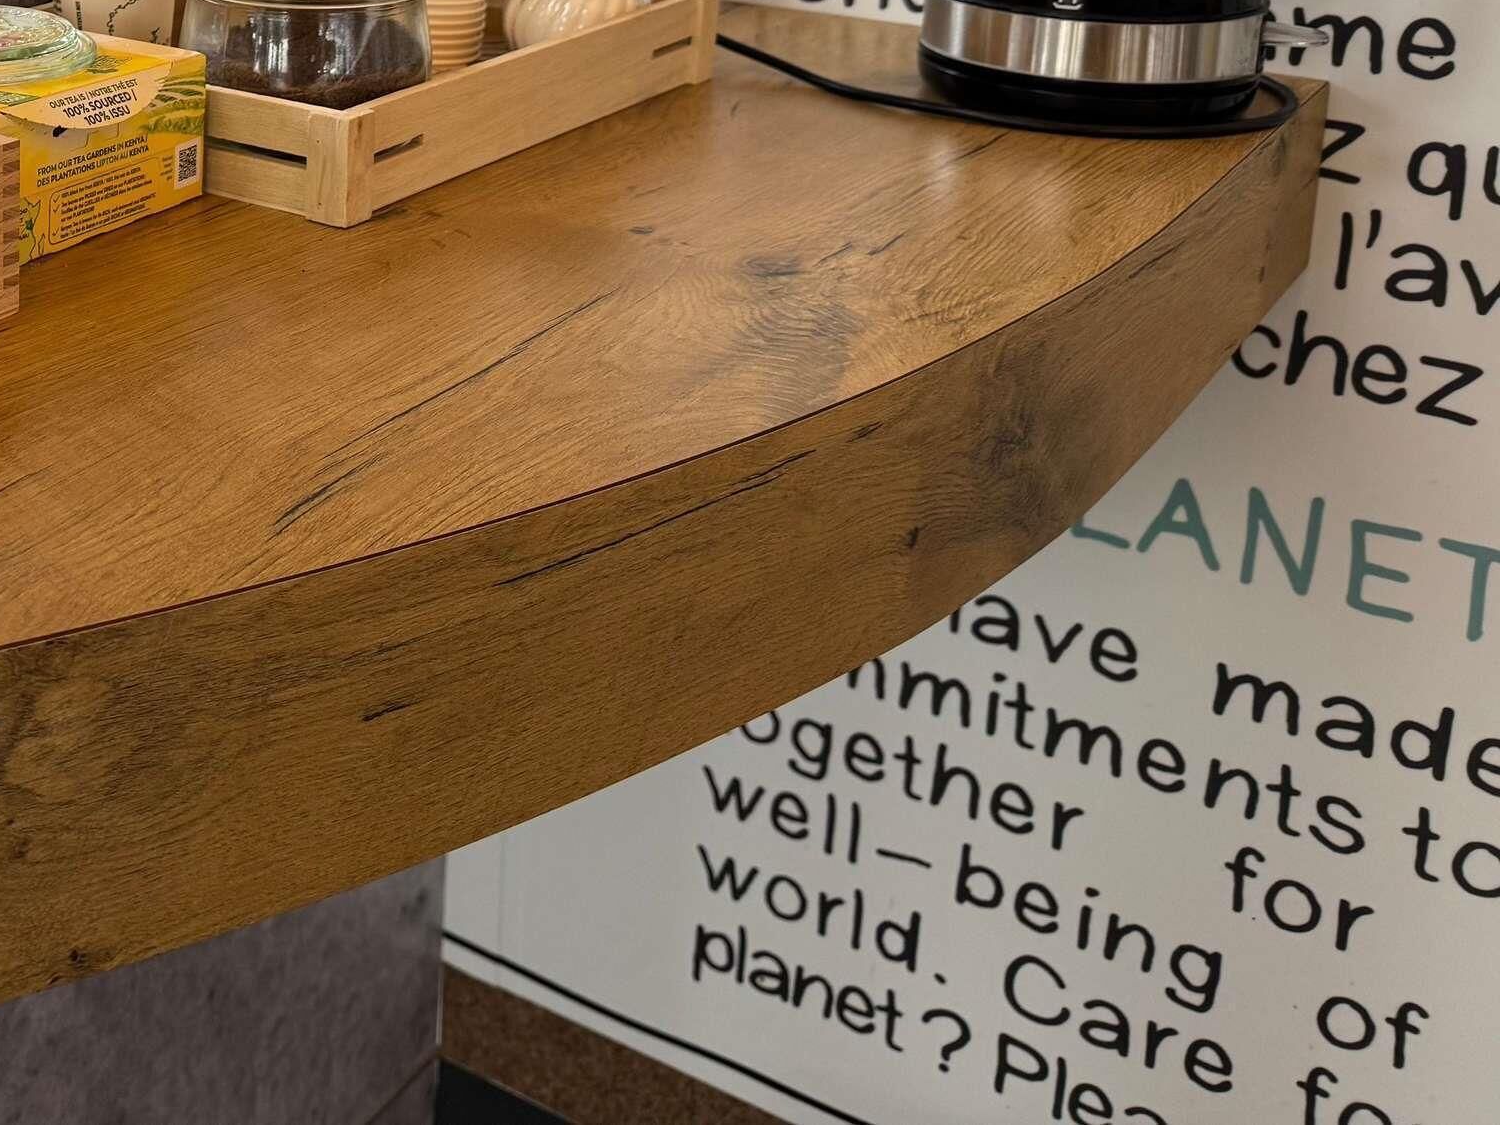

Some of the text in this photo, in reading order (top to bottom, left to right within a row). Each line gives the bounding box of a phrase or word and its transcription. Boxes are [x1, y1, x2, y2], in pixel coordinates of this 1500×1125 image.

[49, 95, 67, 110] OUR
[66, 92, 79, 107] TEA
[78, 91, 87, 103] IS
[90, 84, 115, 99] NOTRE
[125, 78, 139, 89] EST
[63, 91, 132, 119] 100% SOURCED
[83, 105, 131, 126] 100% ISSU
[36, 176, 51, 188] DES
[50, 162, 97, 184] PLANTATIONS
[96, 154, 120, 169] LIPTON
[128, 144, 150, 159] KENYA
[37, 162, 57, 177] FROM
[56, 157, 74, 171] OUR
[72, 154, 88, 167] TEA
[86, 144, 117, 162] GARDENS
[124, 136, 145, 150] KENYA
[1231, 309, 1485, 427] chez
[1070, 477, 1500, 643] LANET
[949, 593, 1500, 801] ave made
[740, 710, 1375, 953] ogether for
[847, 656, 1500, 900] mitments to
[691, 924, 973, 1073] planet?
[697, 843, 948, 986] world.
[1003, 954, 1233, 1093] Care
[1316, 995, 1430, 1070] of
